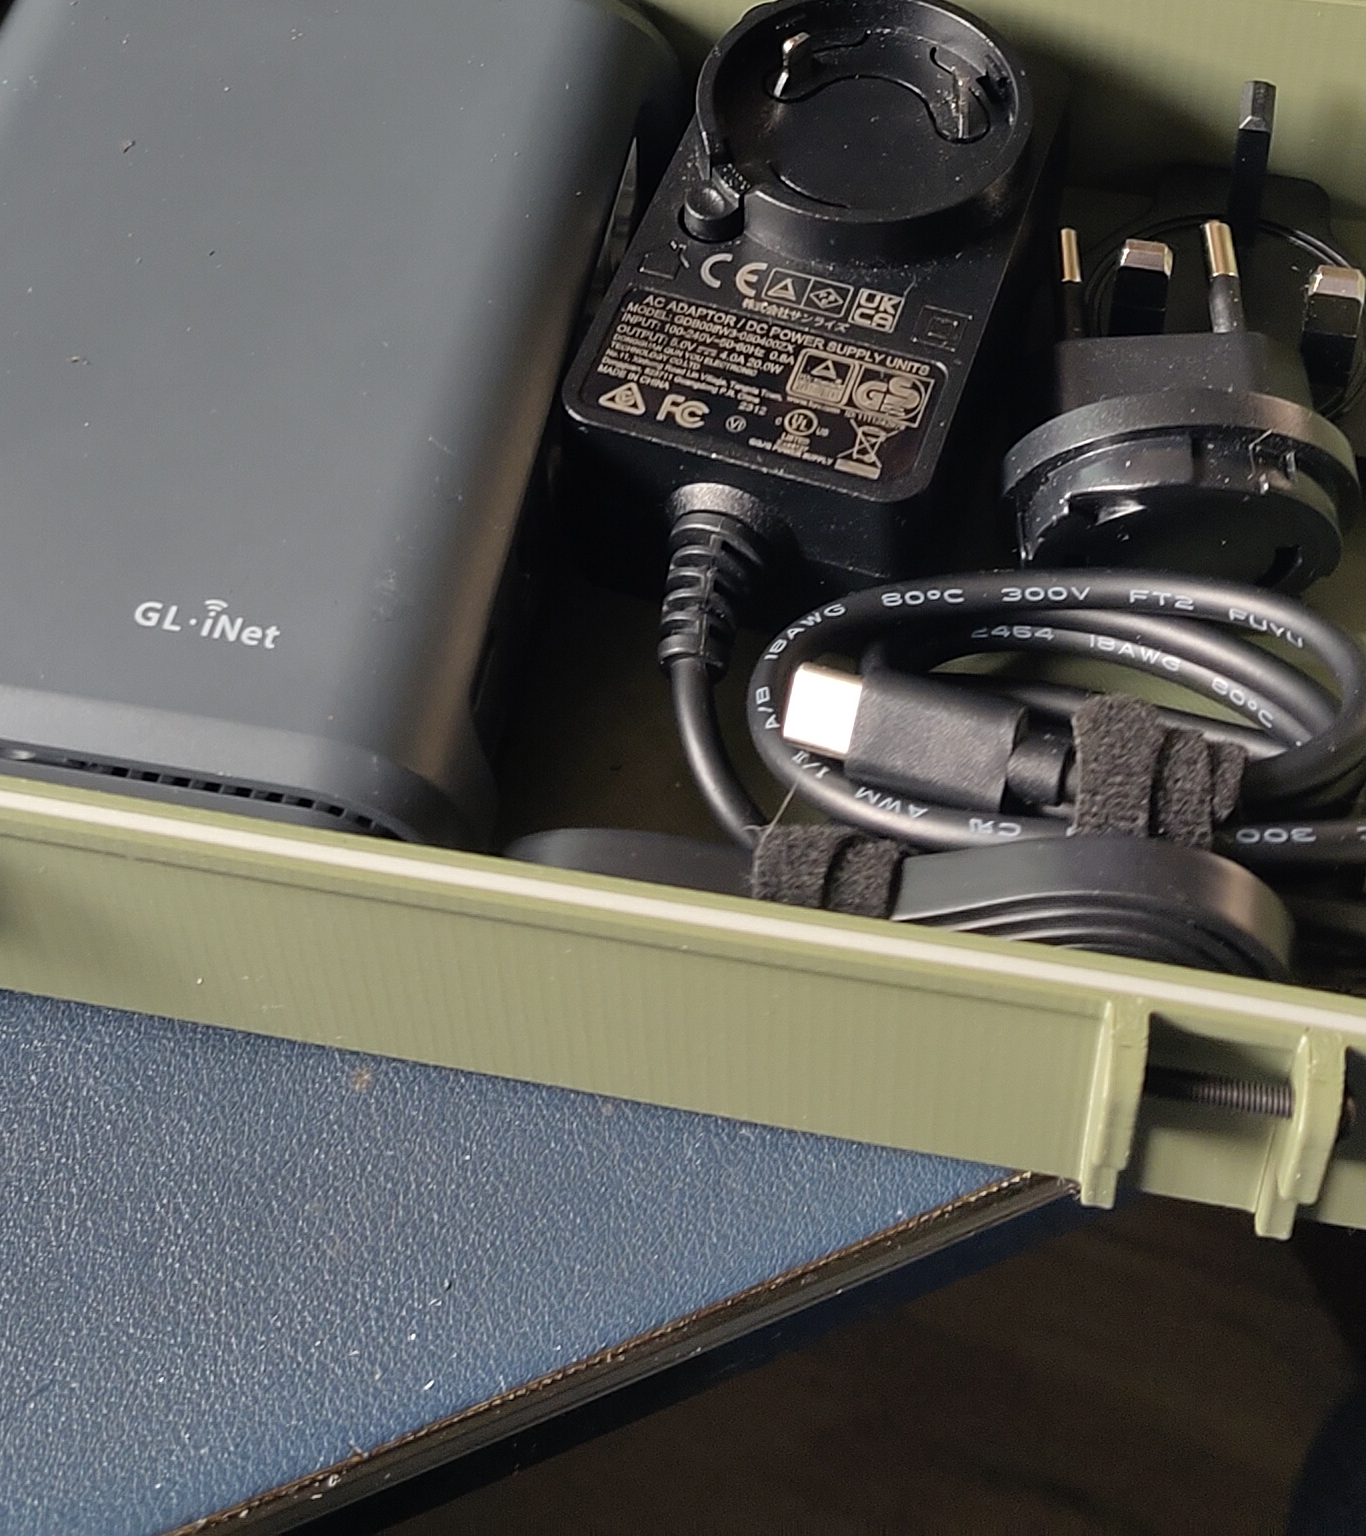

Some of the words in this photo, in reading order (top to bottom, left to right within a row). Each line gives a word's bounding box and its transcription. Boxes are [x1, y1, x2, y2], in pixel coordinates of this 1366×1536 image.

[700, 253, 768, 297] CE
[626, 302, 671, 321] MODEL:
[859, 290, 898, 313] UK
[621, 314, 661, 330] INPUT:
[643, 295, 666, 308] AC
[667, 301, 737, 328] ADAPTOR
[746, 320, 768, 337] DC
[769, 326, 825, 350] POWER
[826, 341, 886, 367] SUPPLY
[886, 356, 930, 376] UNITS
[853, 308, 894, 331] CA
[617, 324, 668, 344] OUTPUT:
[670, 337, 697, 352] 5.0V
[719, 350, 745, 365] 4.0A
[747, 359, 784, 375] 20.0W
[598, 364, 628, 379] MADE
[638, 375, 670, 390] CHINA
[1001, 586, 1091, 603] 300V
[1129, 588, 1195, 611] FT2
[764, 603, 846, 661] 18AWG
[1229, 608, 1304, 649] FUYU
[1090, 634, 1182, 672] 18AWG
[755, 686, 781, 731] A/B
[854, 786, 929, 819] AWM
